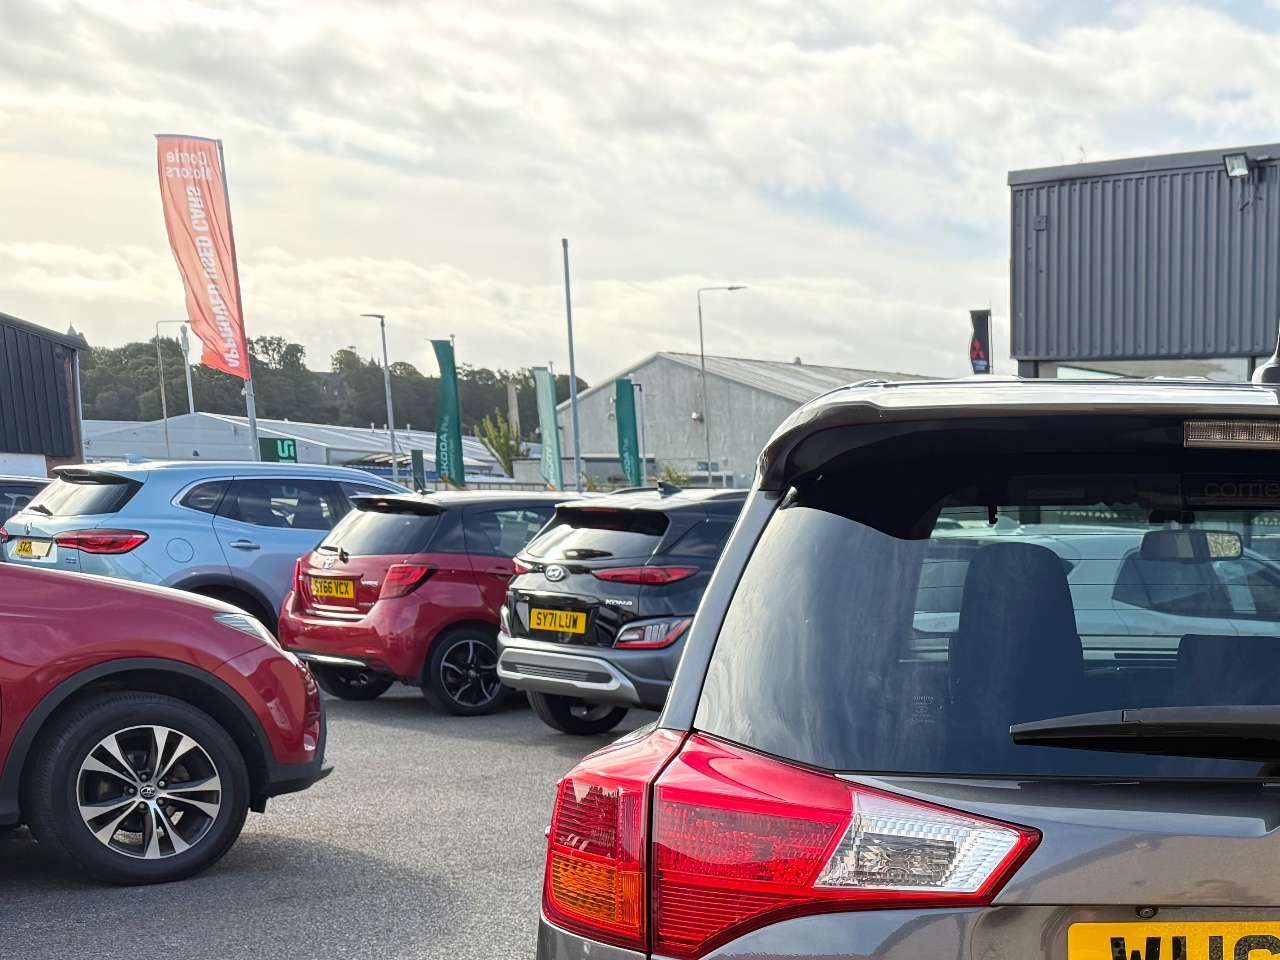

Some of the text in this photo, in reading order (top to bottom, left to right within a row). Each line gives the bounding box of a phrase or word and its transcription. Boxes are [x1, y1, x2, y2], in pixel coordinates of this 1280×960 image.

[334, 581, 349, 595] VCX
[536, 612, 579, 629] SY71 LUW
